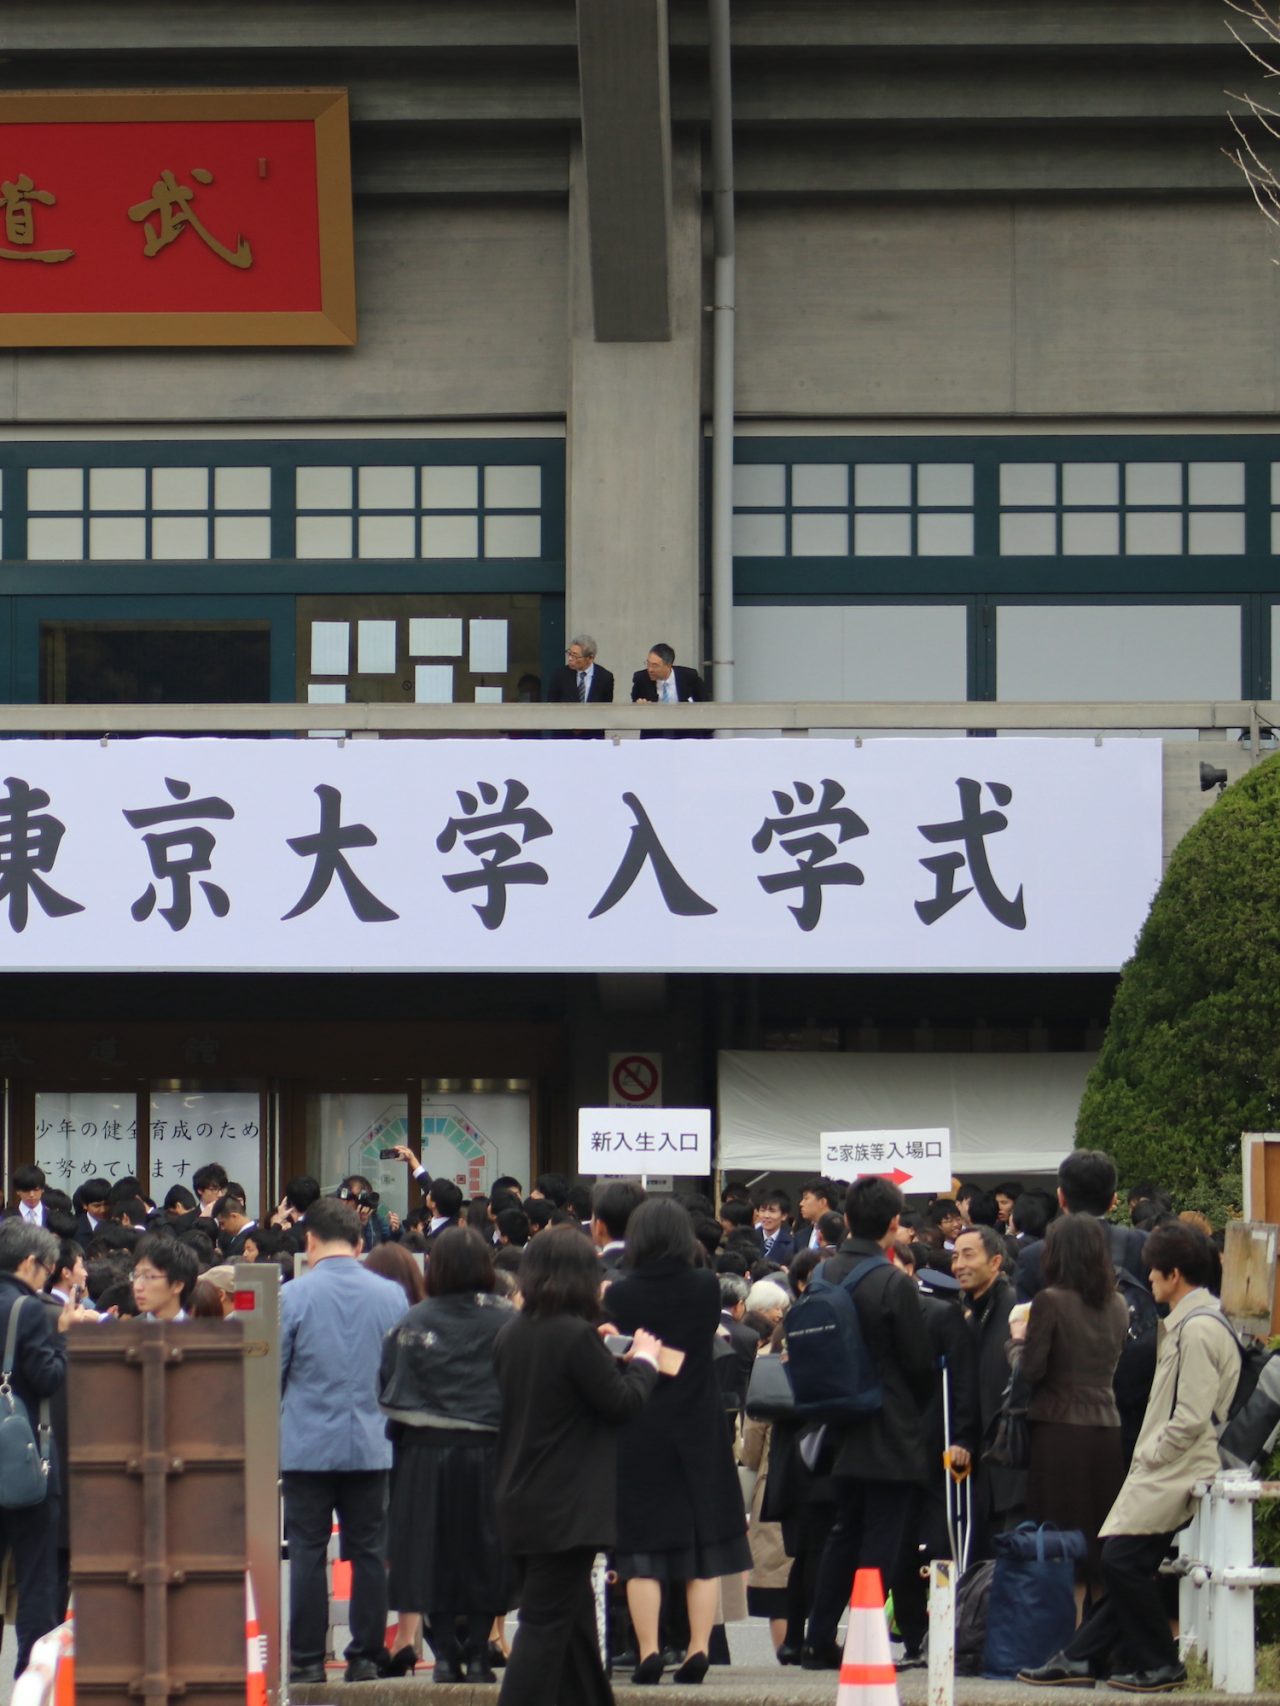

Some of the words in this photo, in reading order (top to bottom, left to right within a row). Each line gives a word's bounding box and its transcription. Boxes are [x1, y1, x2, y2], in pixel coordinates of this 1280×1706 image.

[590, 1131, 699, 1152] 新入生入口
[826, 1141, 942, 1162] ご家族等入場口
